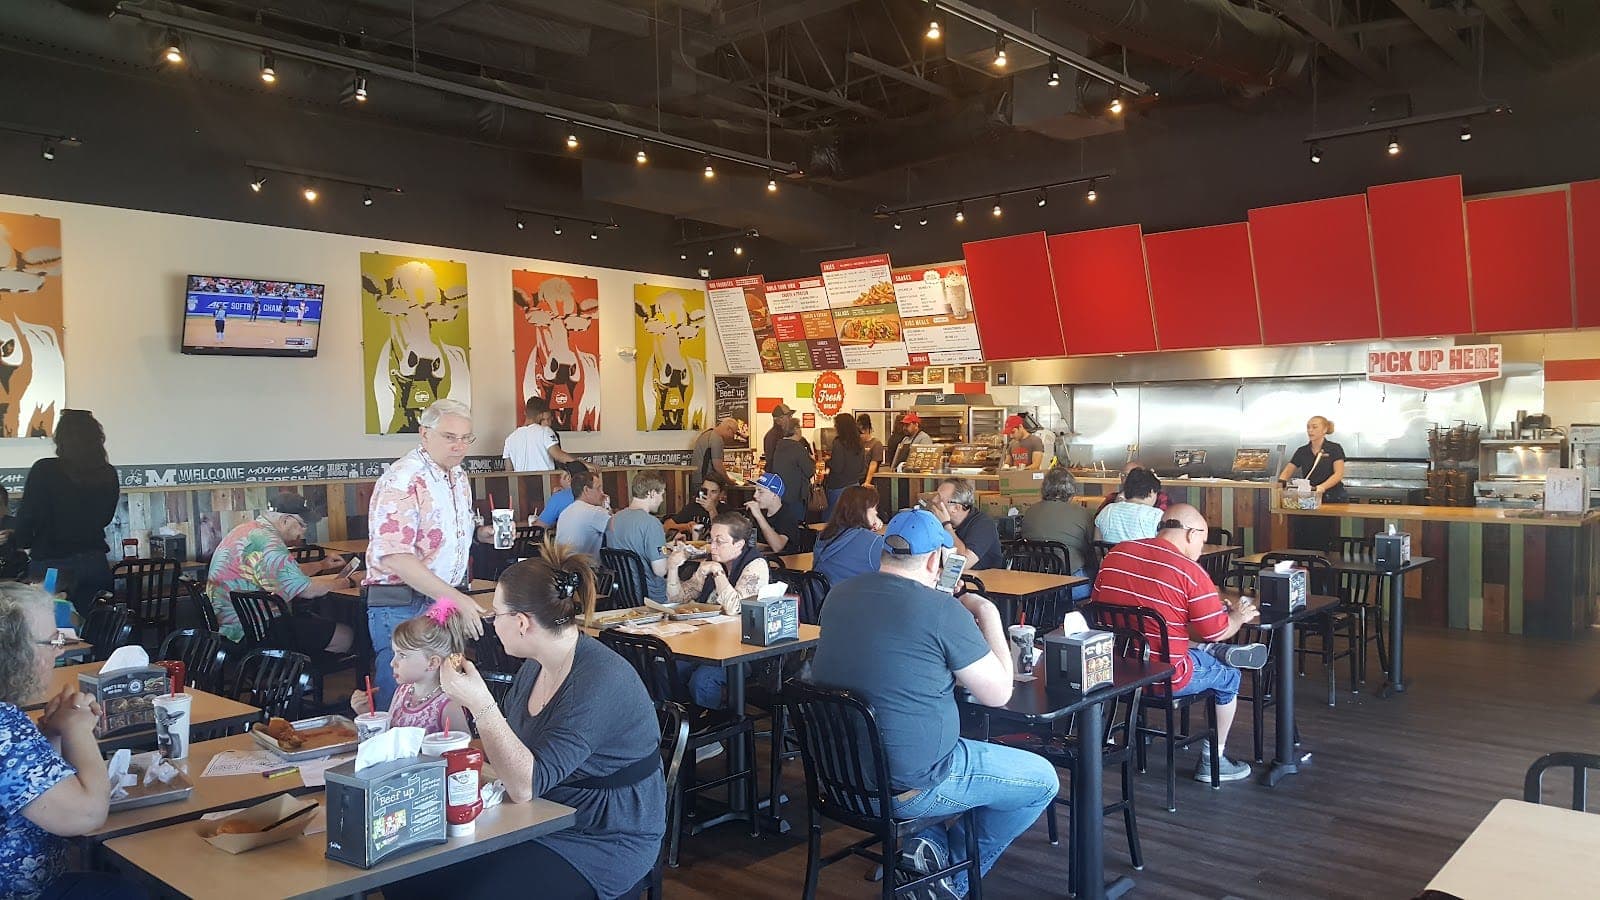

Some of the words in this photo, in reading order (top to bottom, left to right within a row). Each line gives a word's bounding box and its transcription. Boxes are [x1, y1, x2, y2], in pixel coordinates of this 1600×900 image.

[1368, 351, 1412, 373] PICK
[1418, 349, 1444, 371] UP
[1450, 347, 1498, 370] HERE
[719, 388, 735, 398] Beef
[736, 388, 745, 398] up
[817, 389, 842, 403] Fresh
[645, 453, 681, 464] WELCOME
[178, 467, 245, 482] WELCOME
[247, 465, 289, 475] MOOYAH
[379, 790, 401, 807] Beef
[403, 787, 415, 799] up
